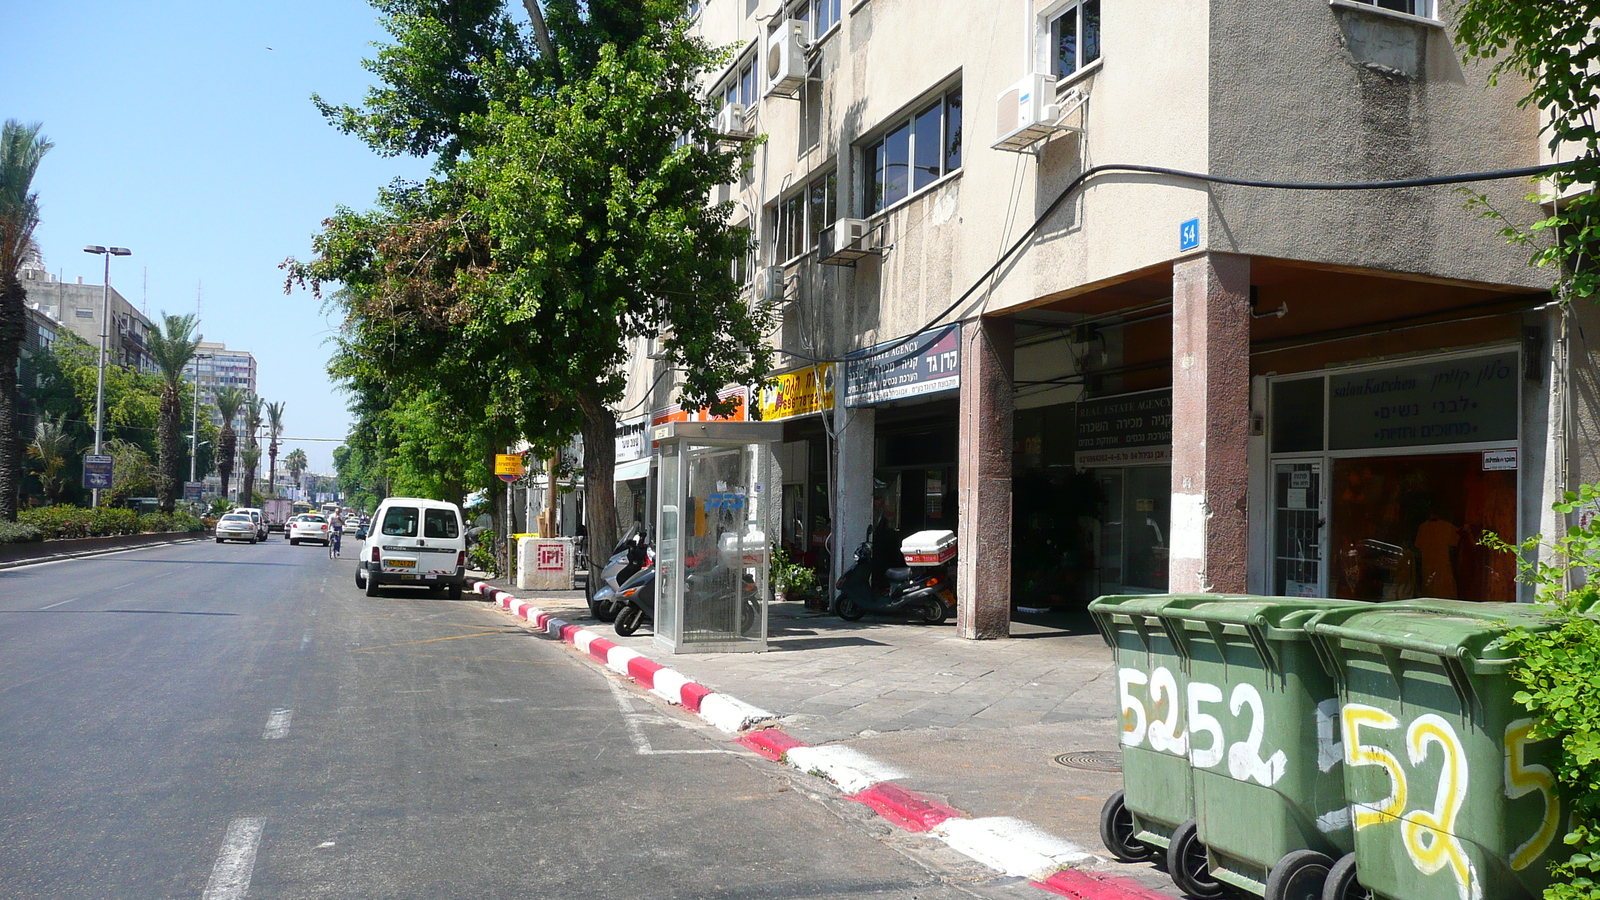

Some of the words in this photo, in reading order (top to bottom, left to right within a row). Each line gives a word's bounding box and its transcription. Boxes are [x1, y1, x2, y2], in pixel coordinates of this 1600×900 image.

[1183, 224, 1195, 245] 54
[891, 341, 919, 357] AGENCY
[901, 357, 919, 370] קניה
[926, 355, 938, 372] גד
[940, 350, 957, 372] קרן
[1080, 406, 1102, 417] REAL
[1104, 402, 1135, 415] ESTATE
[1137, 397, 1171, 411] AGENCY
[1380, 403, 1419, 419] נשים
[1079, 421, 1109, 433] השכרה
[1116, 417, 1143, 430] מכירה
[1118, 666, 1189, 757] 52
[1186, 682, 1289, 788] 52
[1342, 703, 1483, 900] 52
